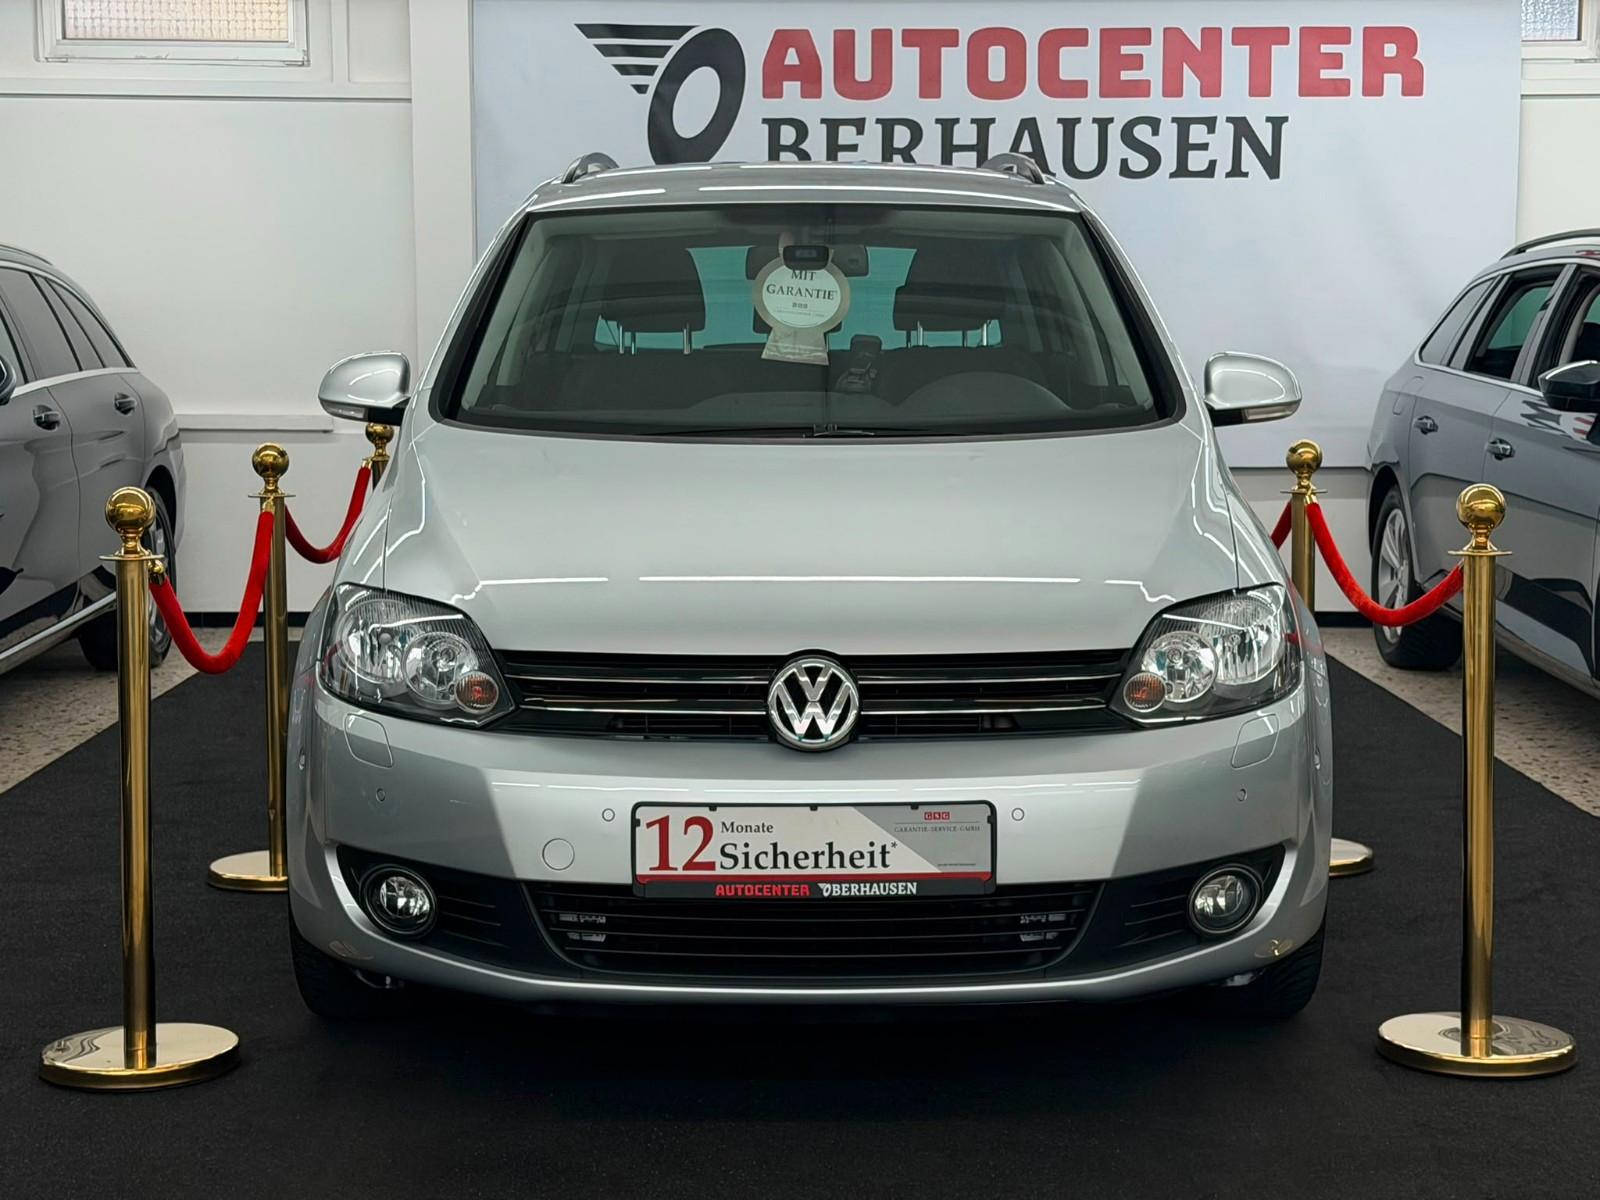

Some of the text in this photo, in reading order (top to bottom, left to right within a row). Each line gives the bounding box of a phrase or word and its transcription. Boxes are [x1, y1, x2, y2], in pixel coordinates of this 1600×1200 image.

[762, 26, 1424, 100] AUTOCENTER
[791, 268, 817, 281] MIT
[765, 284, 836, 301] GARANTIE
[721, 821, 774, 834] Monate
[646, 815, 716, 872] 12
[715, 882, 918, 898] AUTOCENTER OBERHAUSEN
